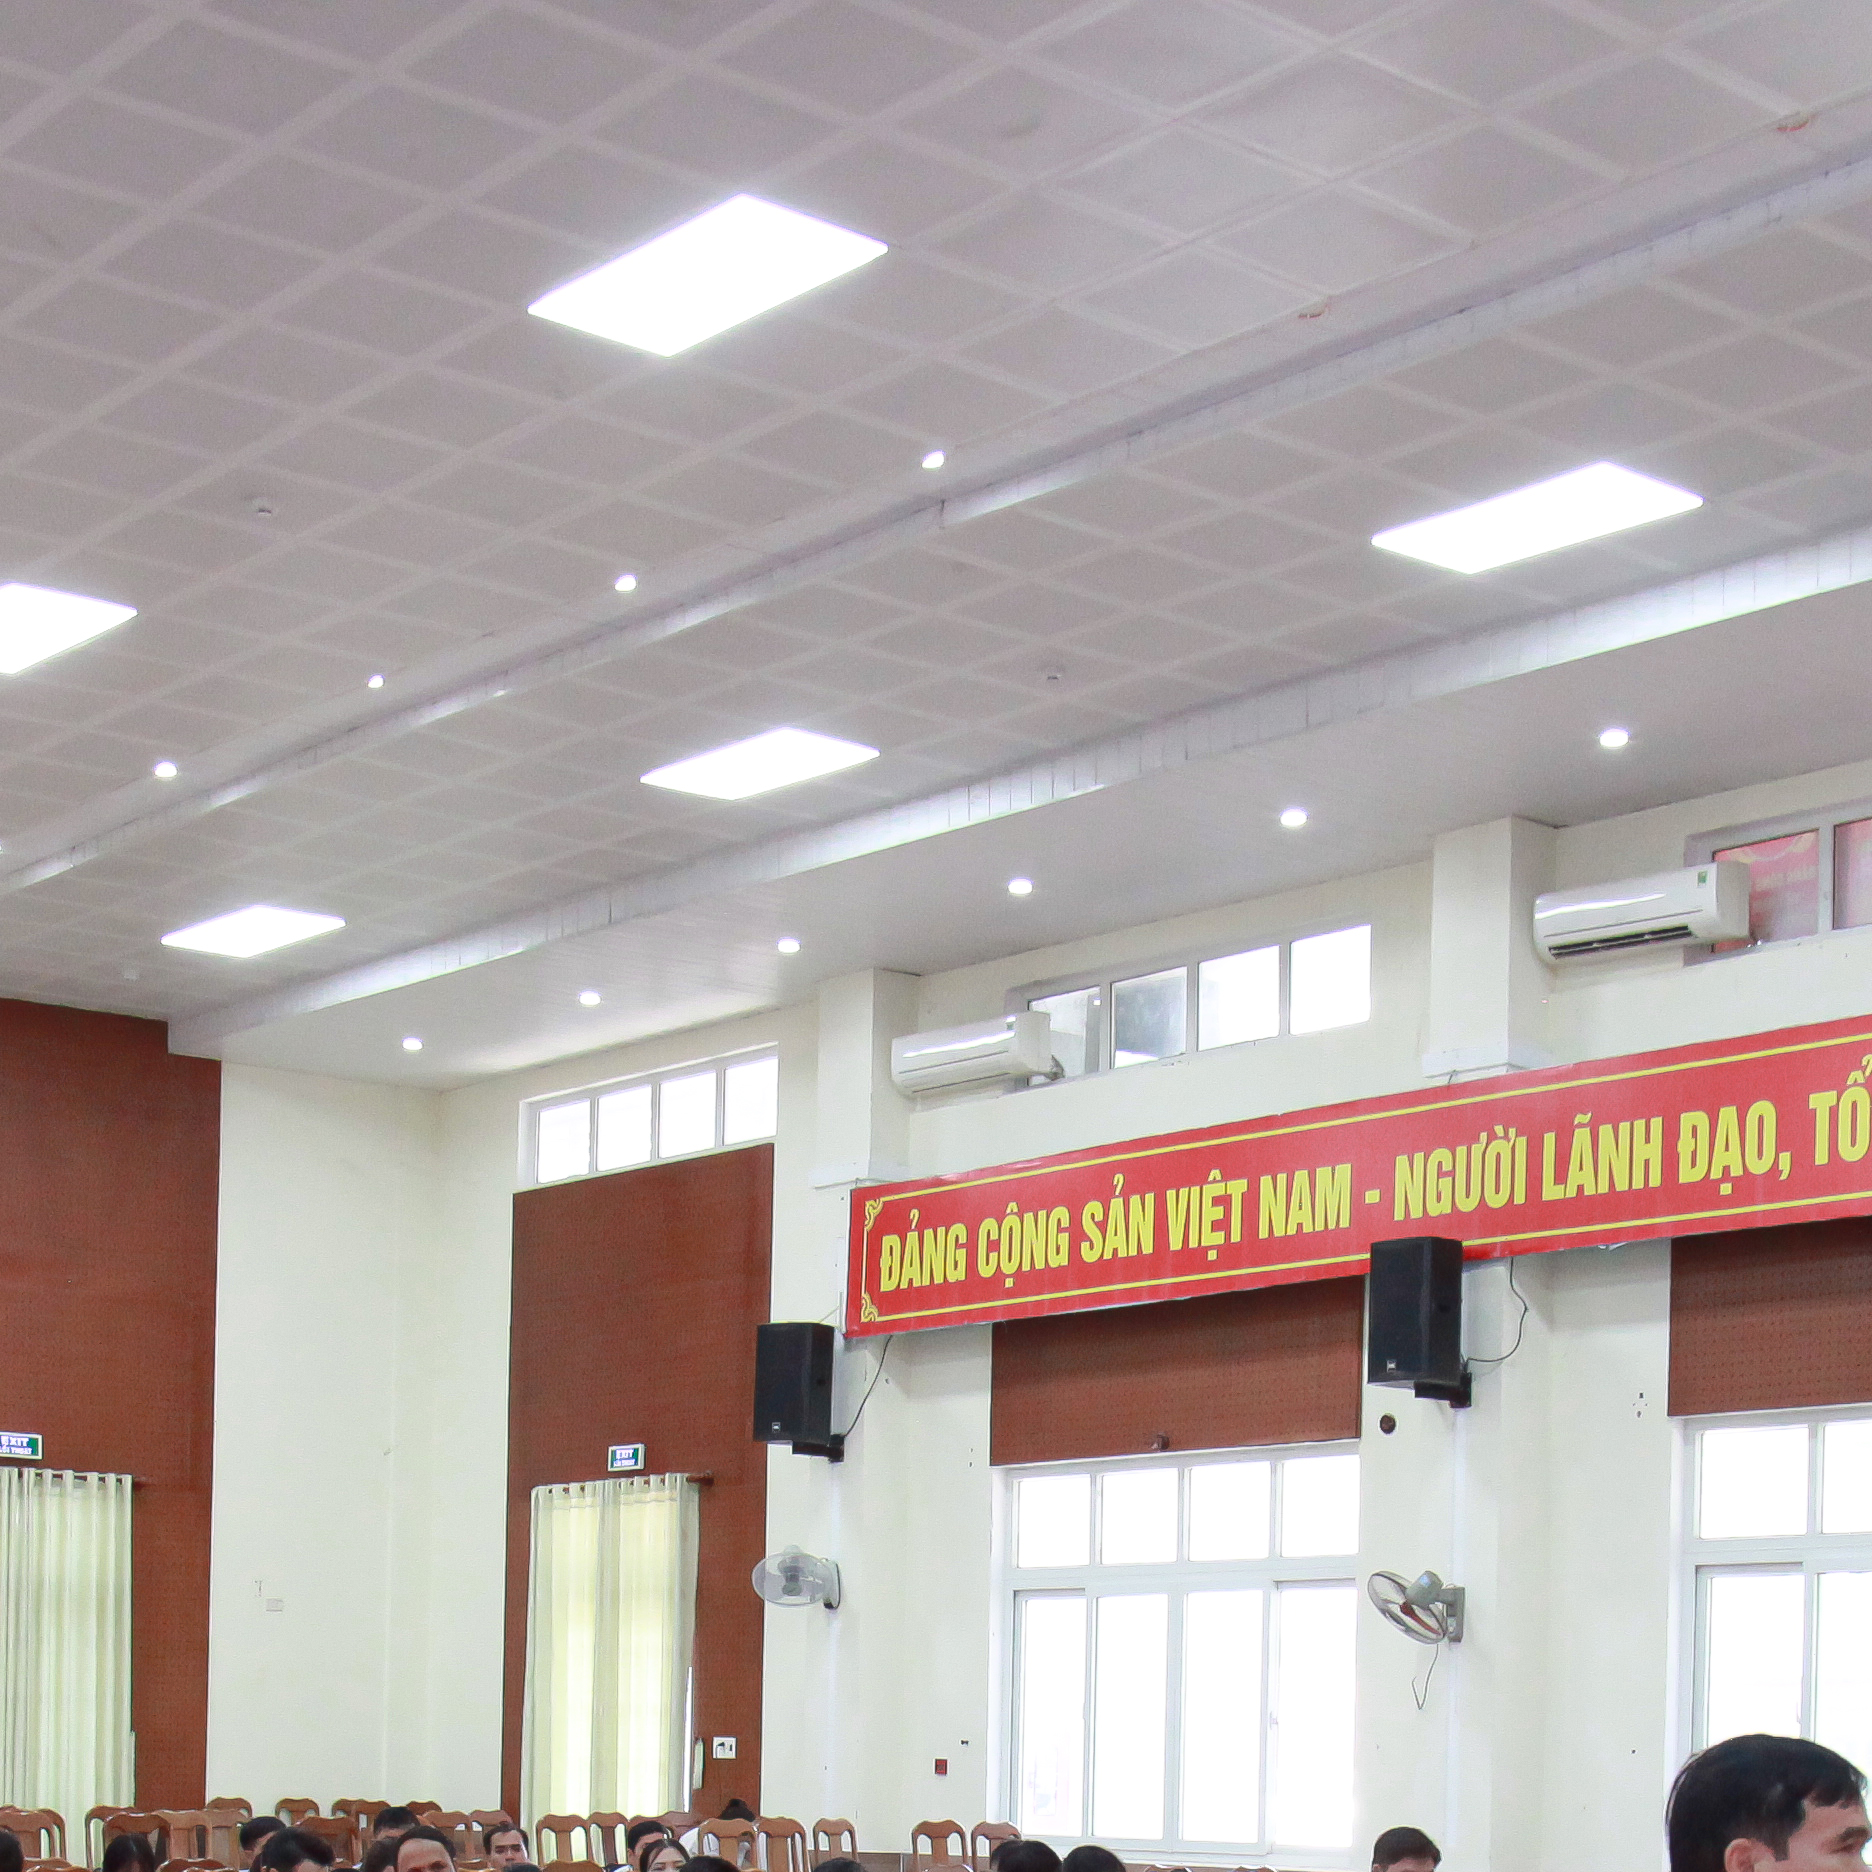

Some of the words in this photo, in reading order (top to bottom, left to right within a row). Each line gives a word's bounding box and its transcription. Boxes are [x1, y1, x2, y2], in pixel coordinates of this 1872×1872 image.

[880, 1209, 968, 1292] ĐẢNG
[977, 1202, 1069, 1288] CỘNG
[1081, 1173, 1155, 1263] SẢN
[1166, 1169, 1248, 1260] VIỆT
[1258, 1163, 1351, 1239] NAM
[1393, 1124, 1526, 1221] NGƯỜI
[1541, 1112, 1663, 1201] LÃNH
[1678, 1100, 1792, 1196] ĐẠO,
[0, 1436, 29, 1446] EXIT
